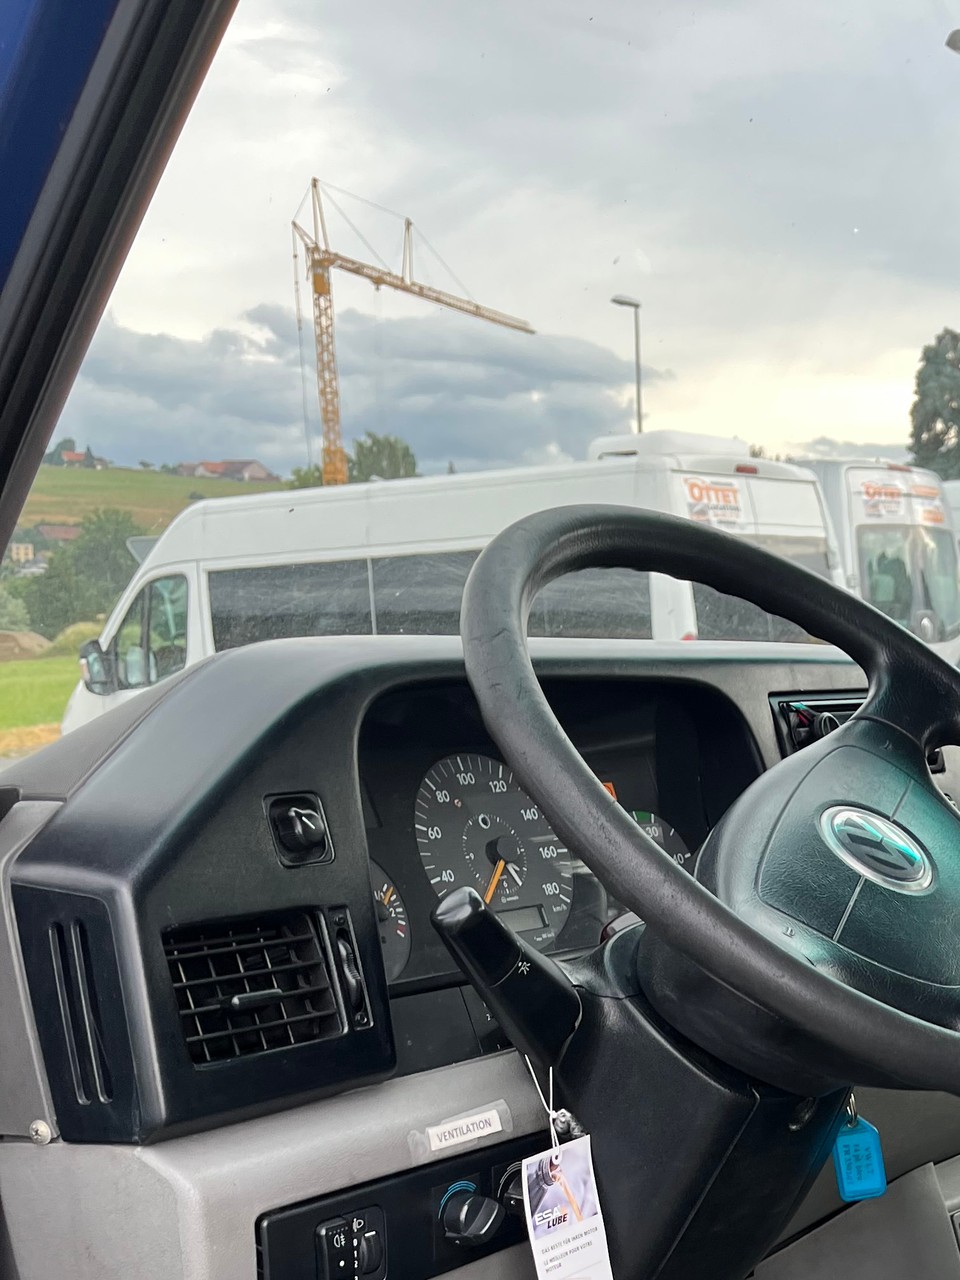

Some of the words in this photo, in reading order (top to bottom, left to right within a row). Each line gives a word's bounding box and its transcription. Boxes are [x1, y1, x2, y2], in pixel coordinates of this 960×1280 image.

[688, 482, 738, 504] OTTET
[457, 773, 475, 785] 100
[489, 780, 507, 793] 120
[436, 790, 450, 803] 80
[520, 808, 538, 821] 140
[428, 827, 442, 839] 60
[645, 826, 659, 838] 30
[539, 846, 557, 859] 160
[441, 870, 455, 882] 40
[503, 880, 508, 888] 6
[542, 882, 560, 896] 180
[437, 1117, 492, 1142] VENTILATION
[547, 1213, 568, 1229] LUBE
[353, 1239, 358, 1247] 0
[354, 1250, 357, 1258] 1
[354, 1260, 358, 1268] 2
